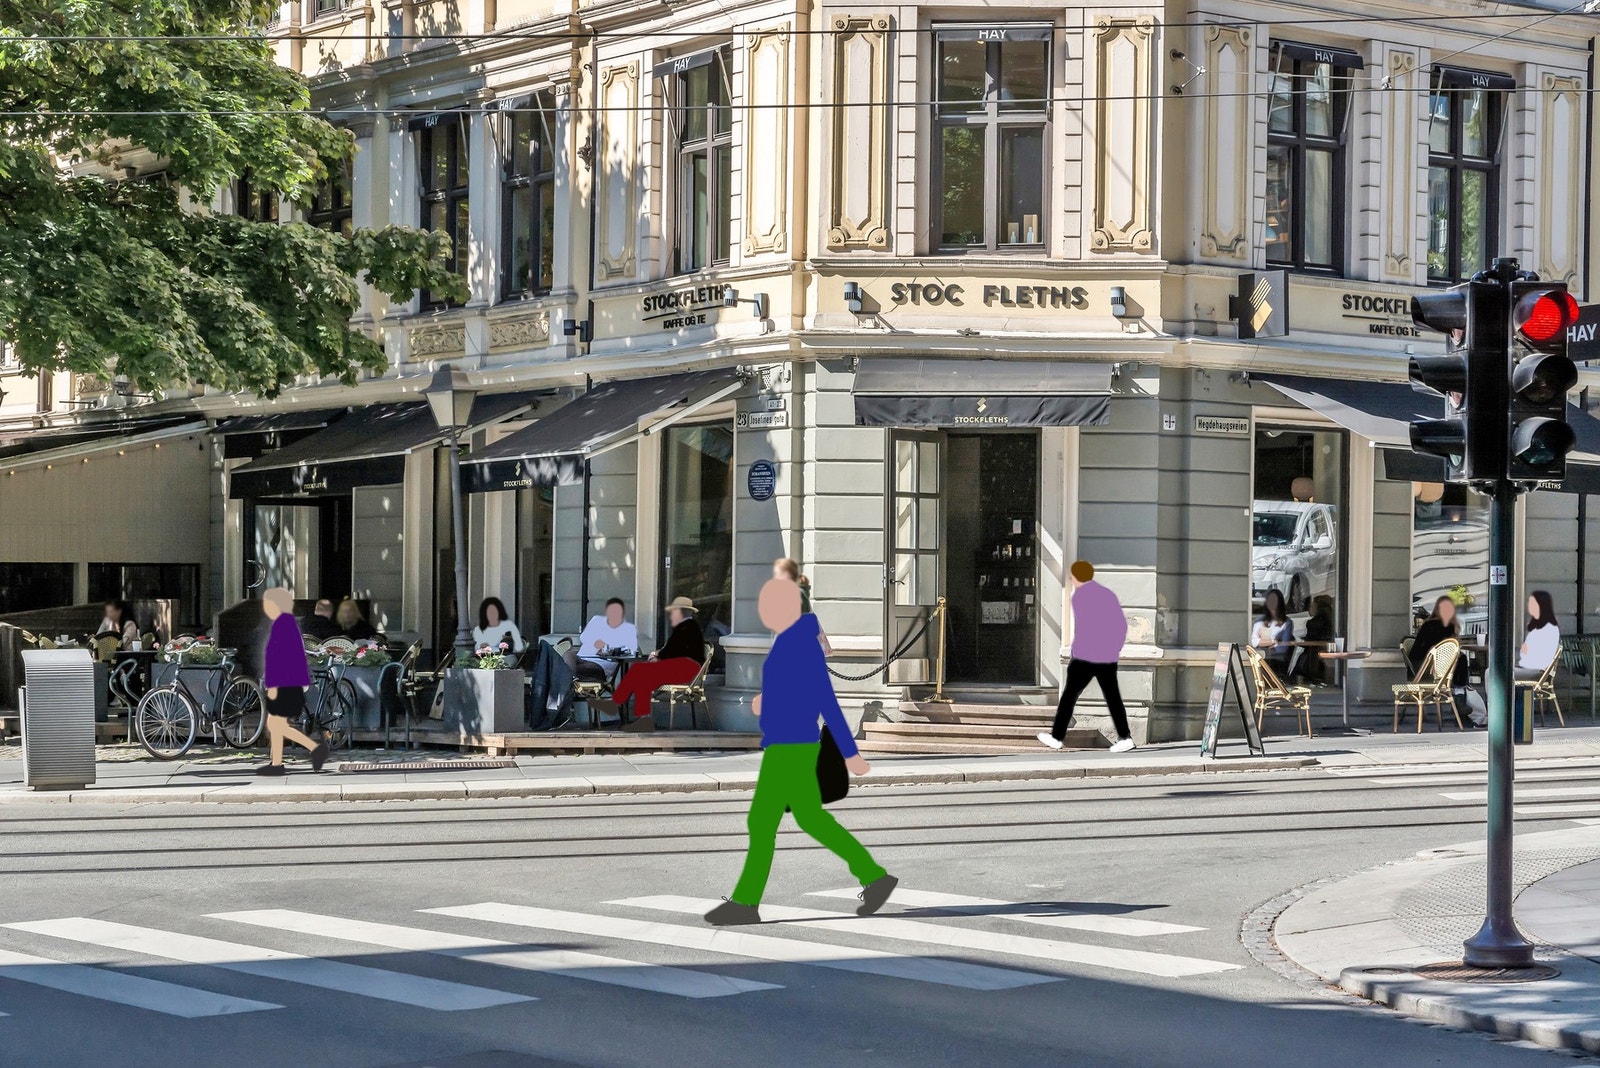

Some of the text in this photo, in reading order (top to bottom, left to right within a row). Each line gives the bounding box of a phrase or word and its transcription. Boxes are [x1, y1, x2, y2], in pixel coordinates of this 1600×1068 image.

[979, 29, 1007, 39] HAY
[1314, 50, 1334, 63] HAY
[673, 56, 691, 74] HAY
[1472, 74, 1490, 87] HAY
[499, 98, 514, 111] HAY
[425, 116, 440, 127] HAY
[891, 282, 1090, 310] STOC FLETHS
[1342, 294, 1411, 315] STOCKFL
[663, 314, 707, 330] KAFFE OG TE
[1369, 323, 1422, 337] KAFFE OG TE
[1566, 323, 1598, 342] HAY
[736, 412, 748, 426] 23
[954, 415, 1009, 424] STOCKFLETHS
[1197, 418, 1248, 432] Hegdehaugsveien
